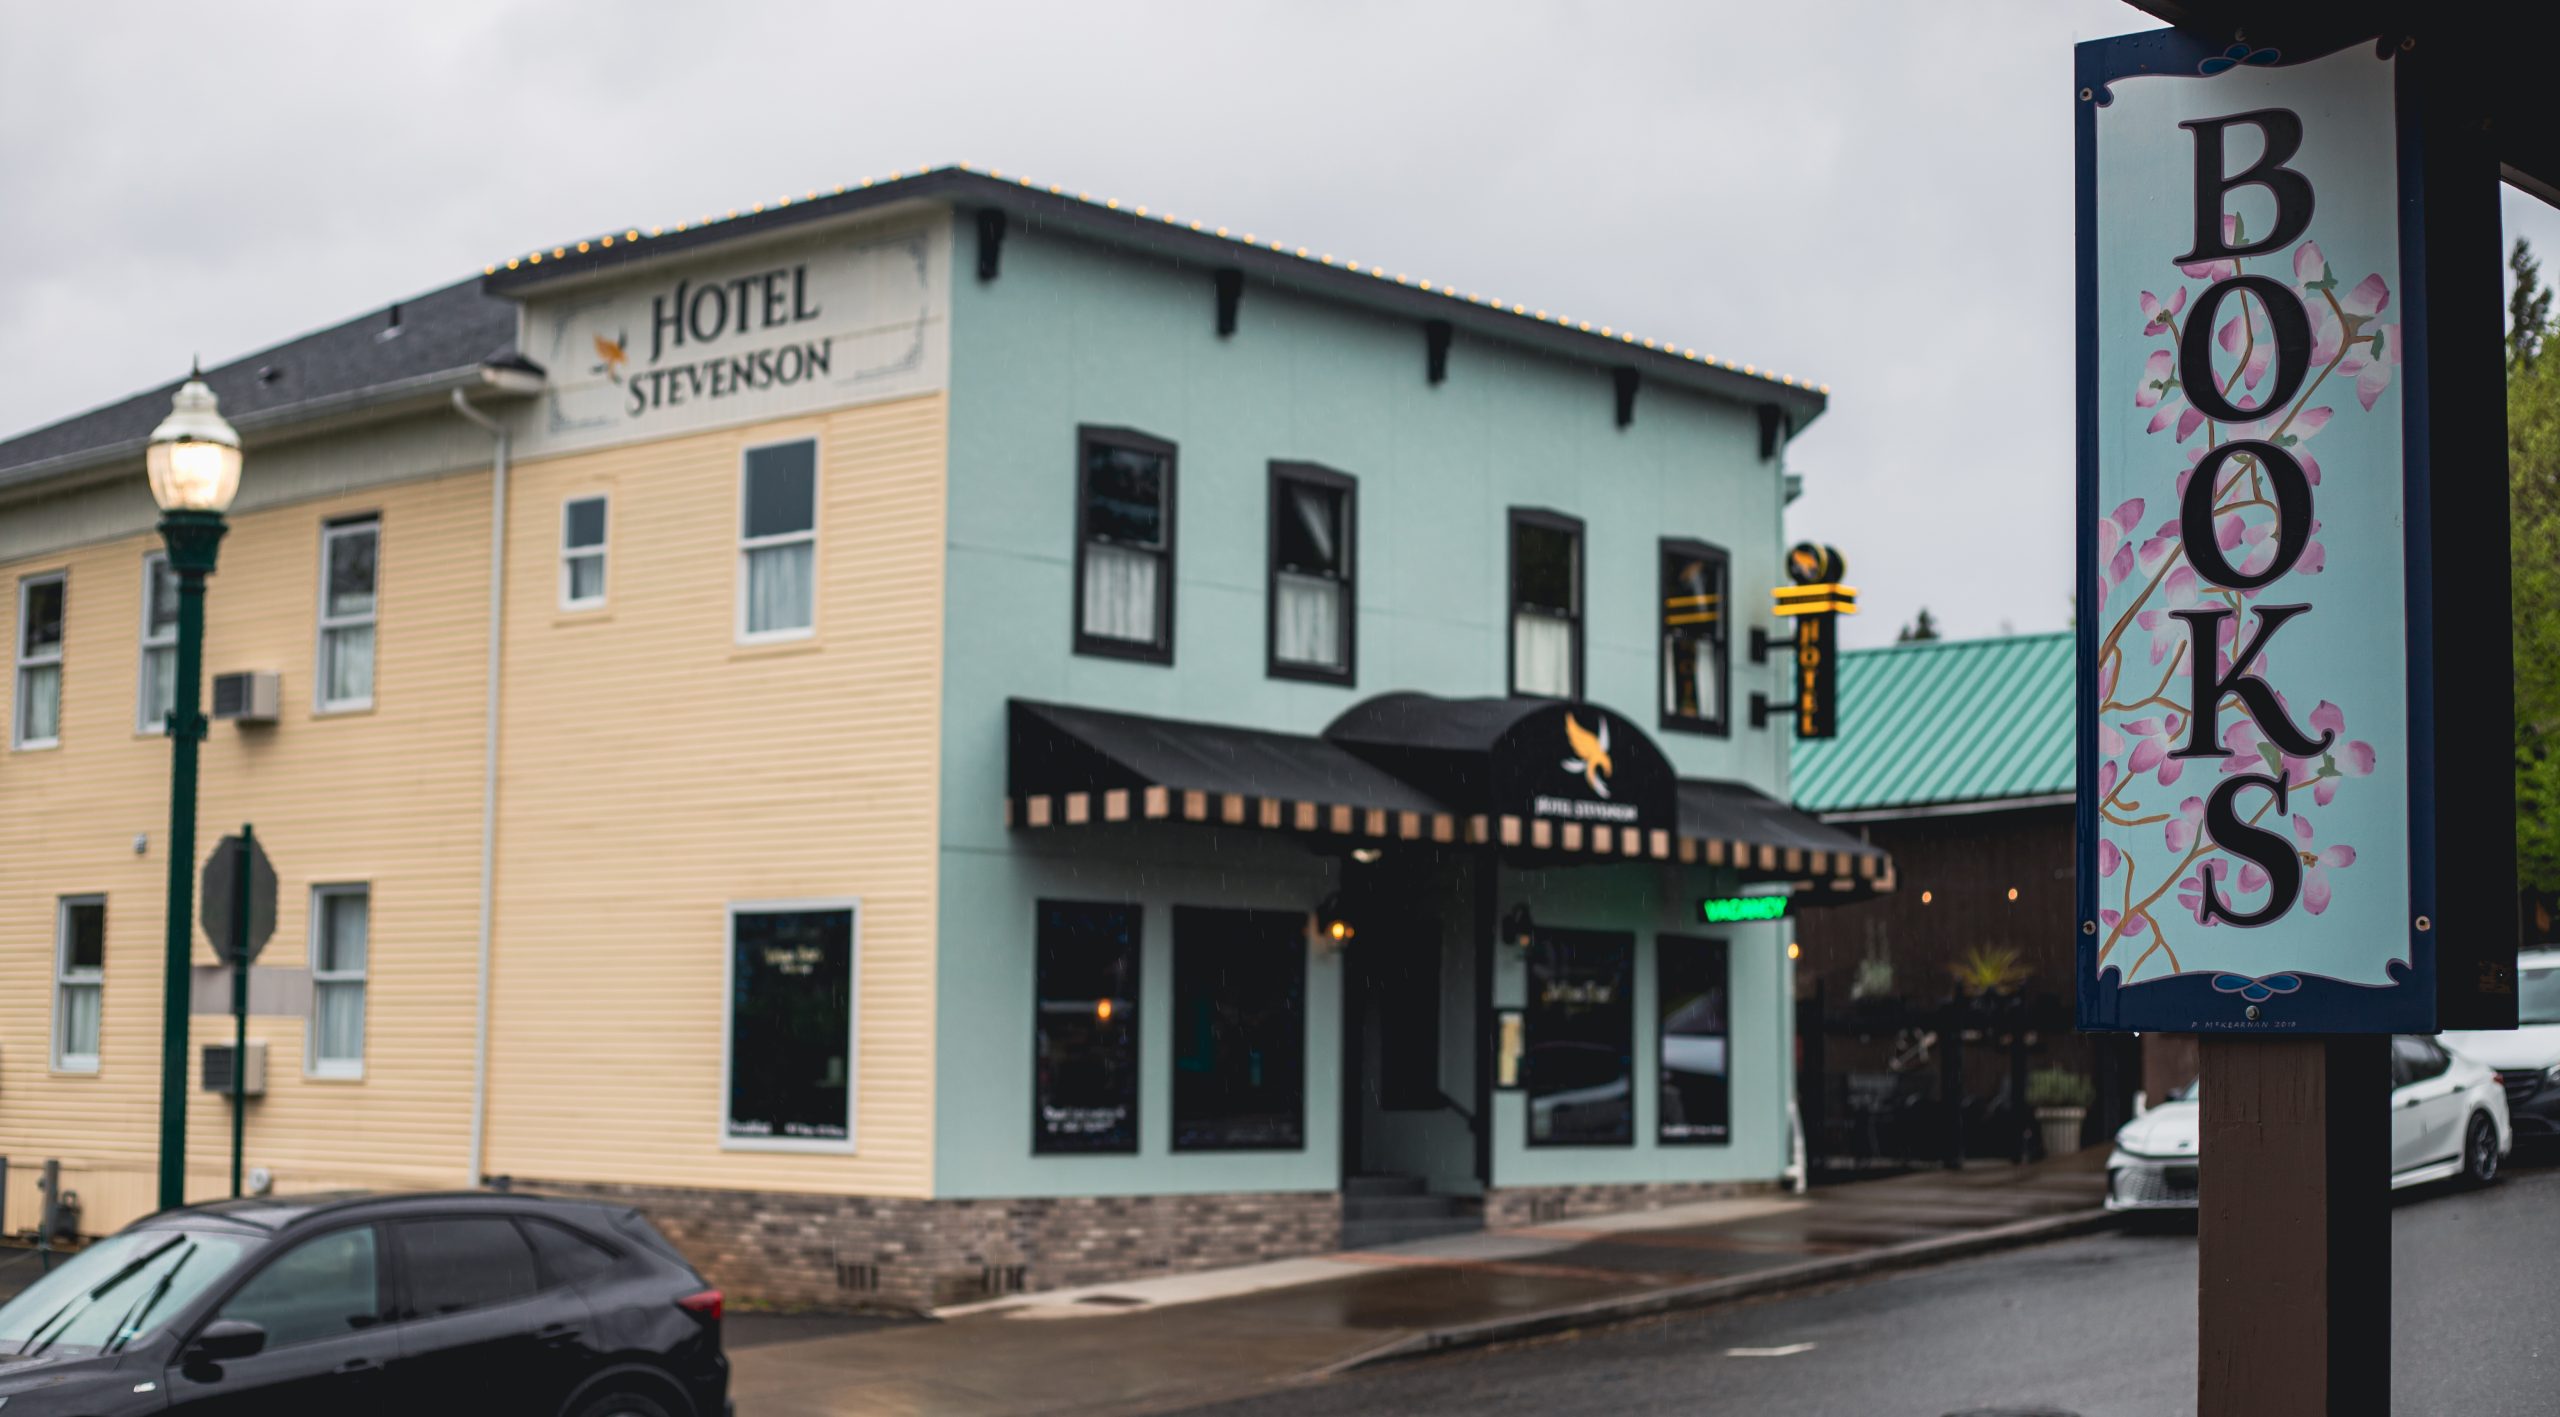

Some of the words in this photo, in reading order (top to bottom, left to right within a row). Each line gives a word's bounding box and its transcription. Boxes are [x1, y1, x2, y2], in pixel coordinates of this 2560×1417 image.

[650, 265, 820, 362] HOTEL
[628, 338, 832, 416] STEVENSON
[2168, 107, 2335, 929] BOOKS
[1799, 617, 1821, 736] HOTEL
